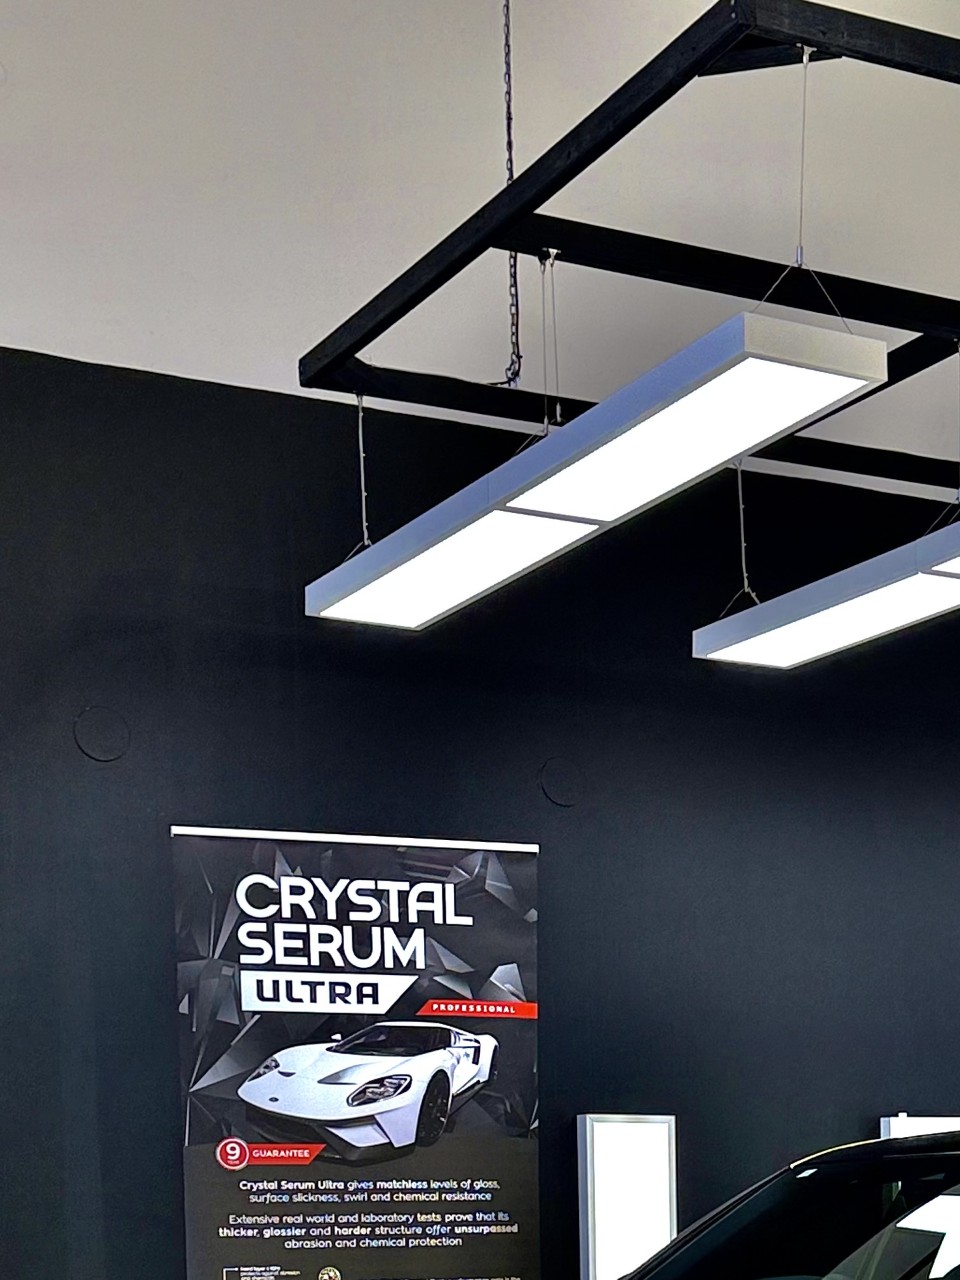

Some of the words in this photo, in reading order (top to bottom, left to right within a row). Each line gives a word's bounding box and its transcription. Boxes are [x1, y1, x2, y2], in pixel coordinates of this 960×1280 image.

[236, 874, 474, 926] CRYSTAL
[237, 922, 426, 969] SERUM
[256, 979, 379, 1005] ULTRA
[432, 1003, 516, 1013] PROFESSIONAL
[225, 1143, 240, 1160] 9
[252, 1149, 310, 1158] GUARANTEE
[240, 1181, 278, 1192] Crystal
[281, 1181, 315, 1190] Serum
[318, 1180, 344, 1190] Ultra
[347, 1180, 374, 1191] gives
[376, 1179, 428, 1189] matchless
[430, 1179, 458, 1188] levels
[460, 1179, 471, 1190] of
[473, 1179, 500, 1190] gloss,
[249, 1193, 290, 1204] surface
[292, 1193, 341, 1203] slickness,
[344, 1192, 368, 1201] swirl
[370, 1192, 391, 1201] and
[393, 1192, 439, 1201] chemical
[441, 1192, 492, 1201] resistance
[229, 1214, 280, 1224] Extensive
[282, 1214, 303, 1223] real
[306, 1214, 335, 1223] world
[338, 1213, 359, 1223] and
[361, 1213, 414, 1224] laboratory
[417, 1213, 442, 1222] tests
[444, 1213, 473, 1223] prove
[476, 1211, 496, 1221] that
[219, 1227, 260, 1238] thicker,
[263, 1227, 306, 1238] glossier
[309, 1226, 331, 1236] and
[334, 1226, 372, 1236] harder
[375, 1225, 422, 1235] structure
[426, 1225, 452, 1236] offer
[454, 1223, 518, 1234] unsurpassed
[284, 1239, 333, 1249] abrasion
[335, 1238, 357, 1248] and
[360, 1237, 406, 1247] chemical
[408, 1237, 462, 1248] protection
